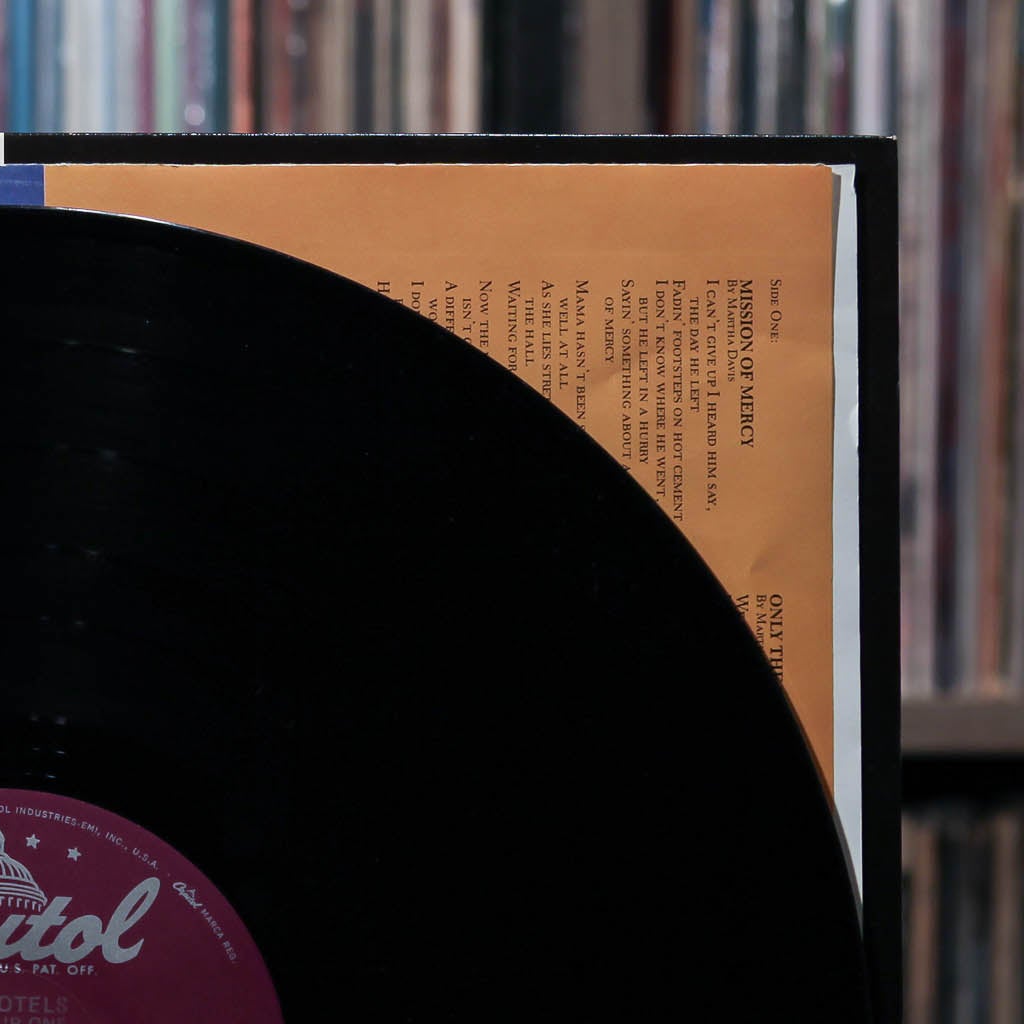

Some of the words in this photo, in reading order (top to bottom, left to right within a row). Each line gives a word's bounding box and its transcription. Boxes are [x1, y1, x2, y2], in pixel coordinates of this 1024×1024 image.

[622, 280, 635, 324] SAYIN'
[727, 280, 738, 294] BY
[770, 280, 781, 305] SIDE
[605, 297, 614, 314] OF
[639, 298, 648, 323] BUT
[656, 291, 669, 331] DON'T
[673, 280, 685, 326] FADIN'
[690, 297, 699, 324] THE
[707, 290, 720, 331] CAN'T
[740, 280, 753, 352] MISSION
[728, 298, 737, 345] MARTHA
[771, 311, 782, 342] ONE:
[605, 319, 614, 363] MERCY
[639, 329, 648, 346] HE
[690, 329, 699, 352] DAY
[707, 336, 716, 366] GIVE
[622, 329, 631, 408] SOMETHING
[639, 351, 648, 383] LEFT
[656, 337, 665, 377] KNOW
[673, 331, 682, 403] FOOTSTEPS
[690, 358, 699, 376] HE
[728, 350, 738, 382] DAVIS
[740, 357, 753, 381] OF
[707, 370, 716, 387] UP
[640, 388, 648, 401] IN
[656, 383, 665, 429] WHERE
[690, 381, 699, 412] LEFT
[640, 408, 648, 416] A
[673, 408, 682, 427] ON
[707, 403, 716, 446] HEARD
[741, 386, 753, 447] MERCY
[622, 414, 631, 459] ABOUT
[640, 422, 648, 464] HURRY
[657, 435, 665, 452] HE
[673, 433, 682, 461] HOT
[708, 452, 716, 478] HIM
[672, 465, 682, 522] CEMENT
[706, 484, 717, 511] SAY,
[770, 594, 783, 640] ONLY
[201, 908, 224, 939] MARCA
